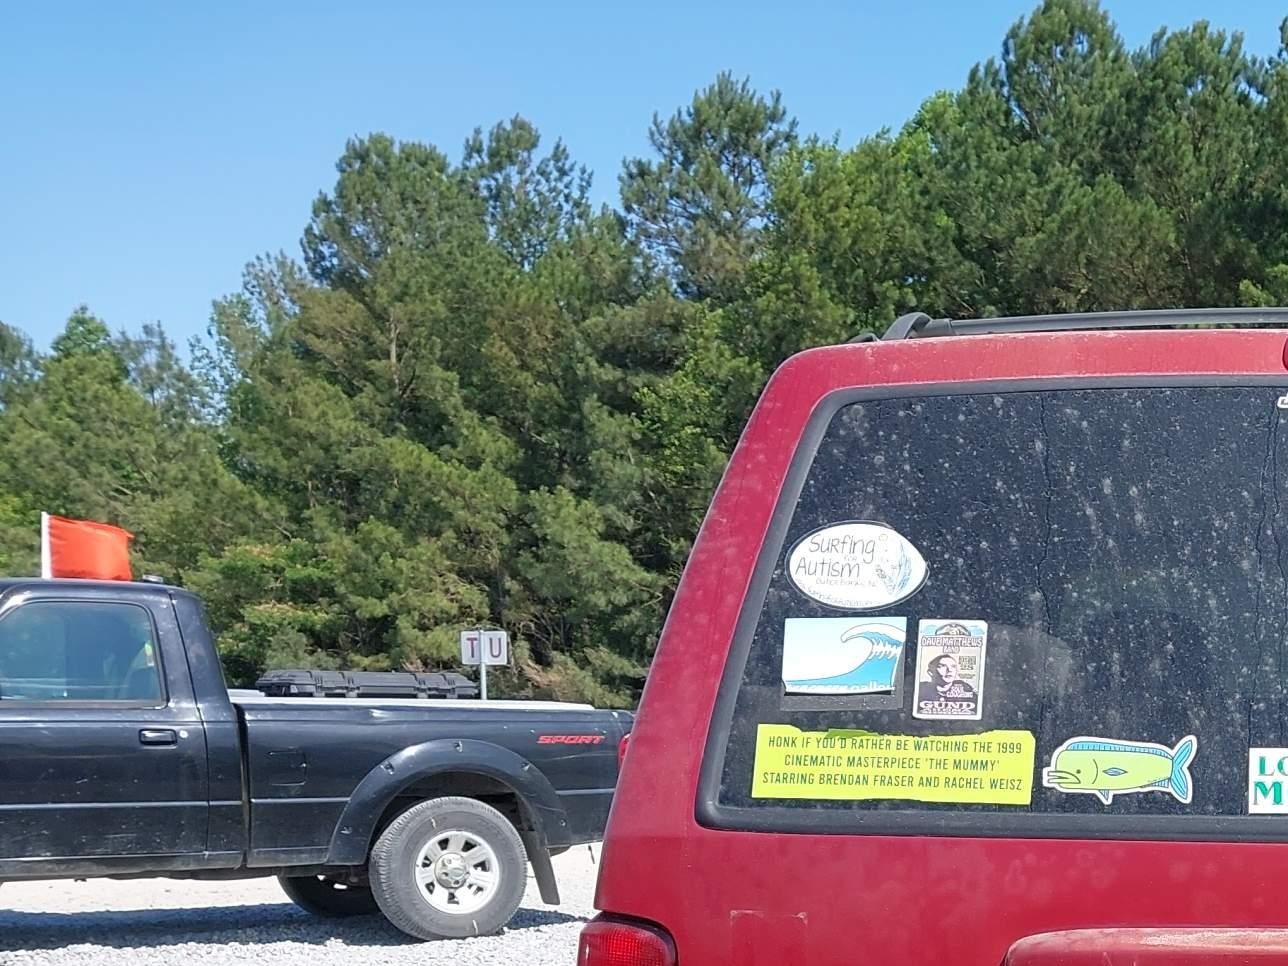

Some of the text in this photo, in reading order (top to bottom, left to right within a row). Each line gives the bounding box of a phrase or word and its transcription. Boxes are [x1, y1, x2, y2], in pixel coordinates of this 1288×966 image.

[795, 557, 860, 578] Autism
[466, 637, 501, 658] T U
[921, 636, 983, 648] DAVE MATTHEWS
[537, 735, 605, 744] SPORT
[768, 736, 1022, 754] HONK IF YOU'D RATHER BE WATCHING THE 1999
[784, 754, 1000, 772] CINEMATIC MASTERPIECE 'THE MUMMY'
[762, 772, 1022, 791] STARRING BRENDAN FRASER AND RACHEL WEISZ
